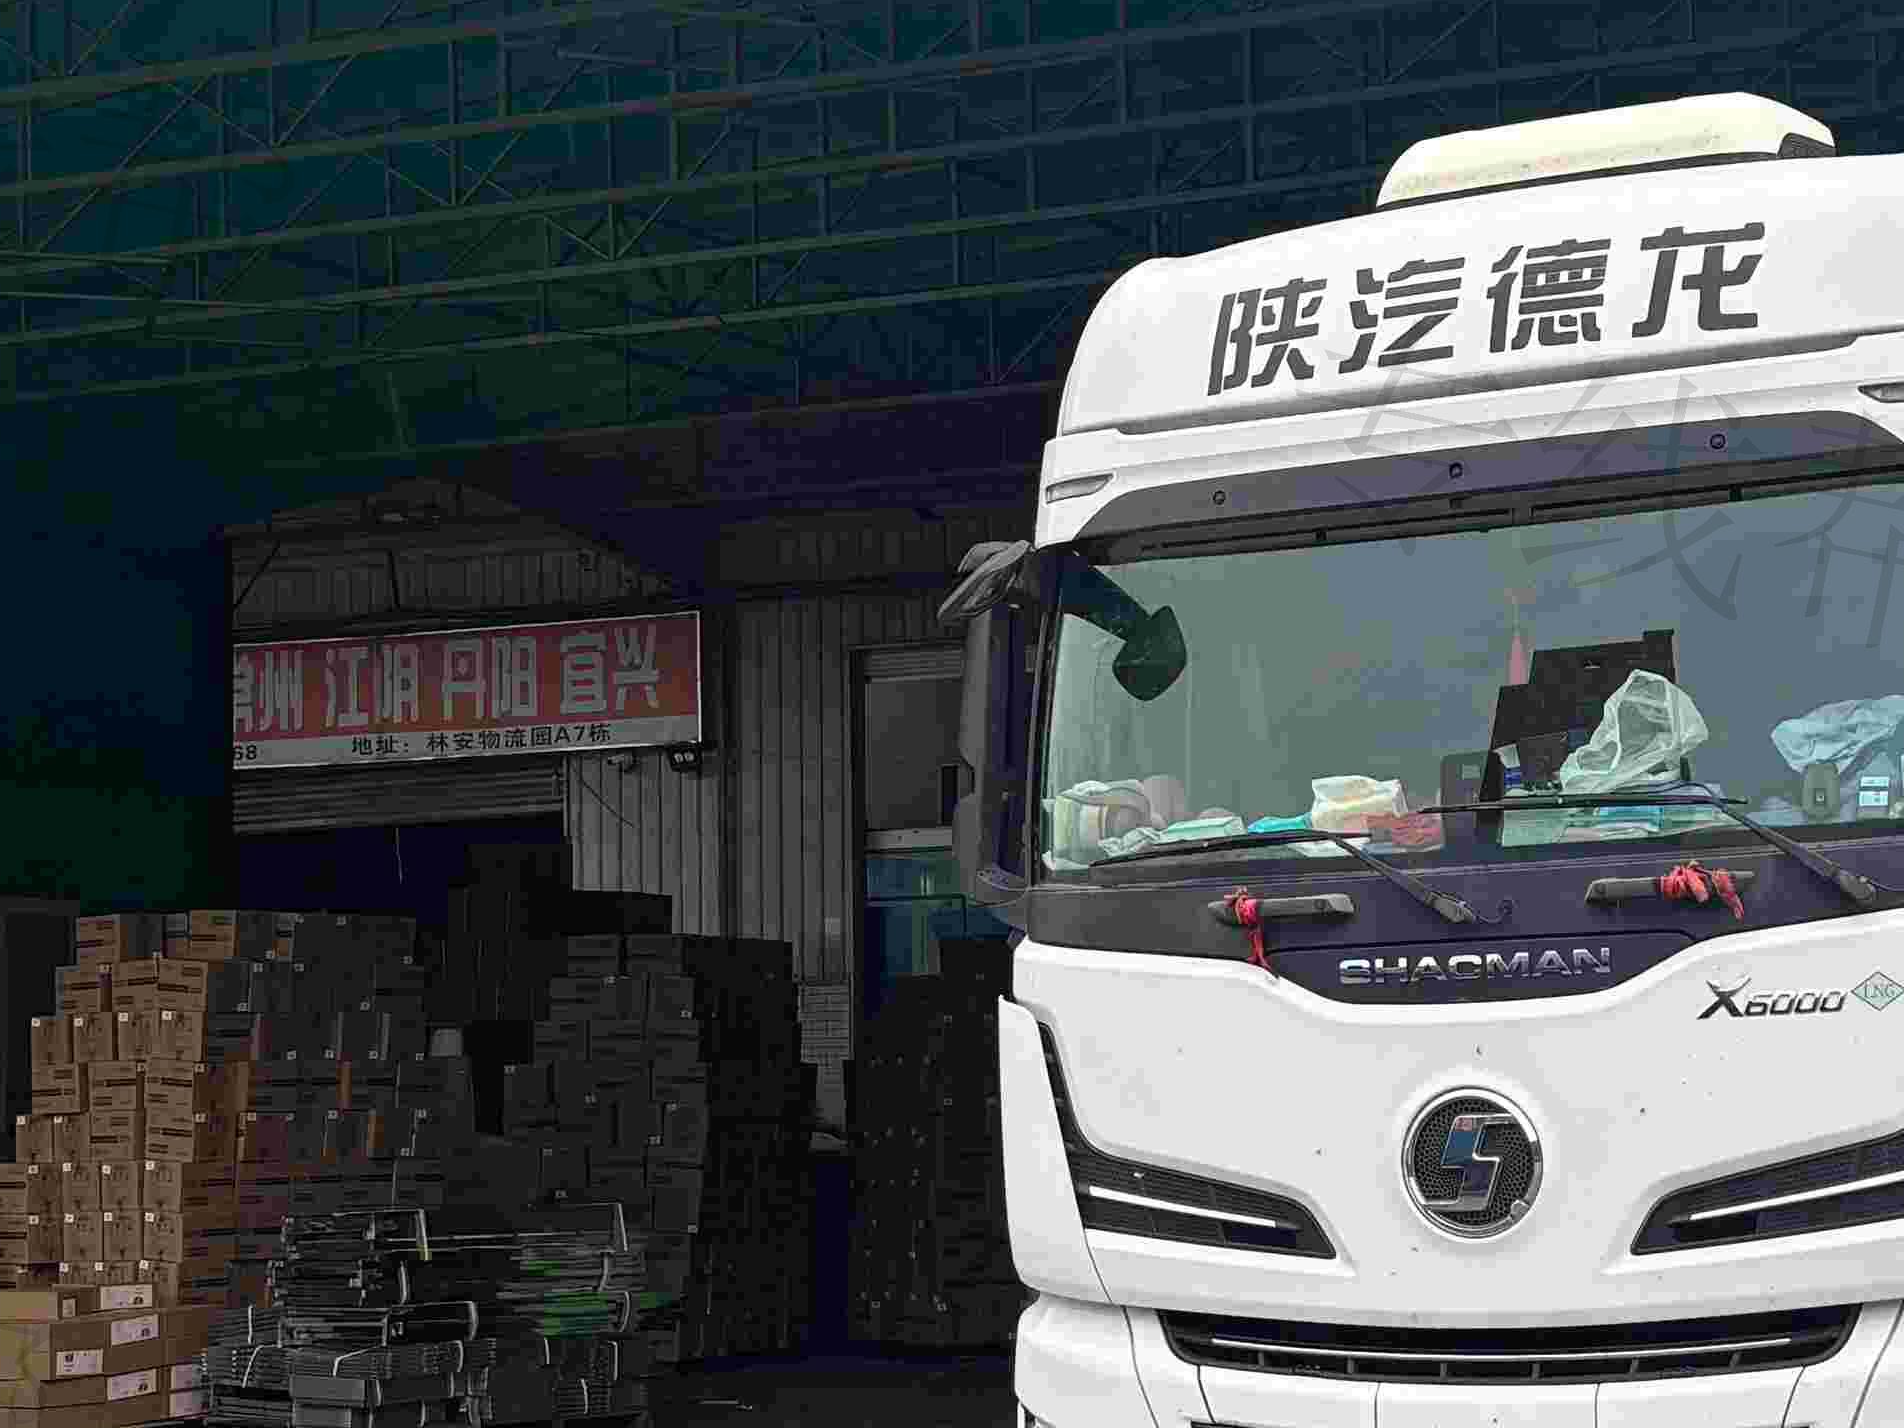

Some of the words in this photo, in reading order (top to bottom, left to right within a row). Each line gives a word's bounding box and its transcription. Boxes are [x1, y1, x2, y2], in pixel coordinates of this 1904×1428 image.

[1207, 222, 1765, 396] 陕汽德龙
[325, 644, 421, 727] 江阴
[441, 634, 539, 721] 丹阳
[560, 624, 661, 715] 宜兴
[1339, 948, 1610, 985] SHACMAN
[1697, 975, 1848, 1020] X6000
[1862, 982, 1896, 999] LNG
